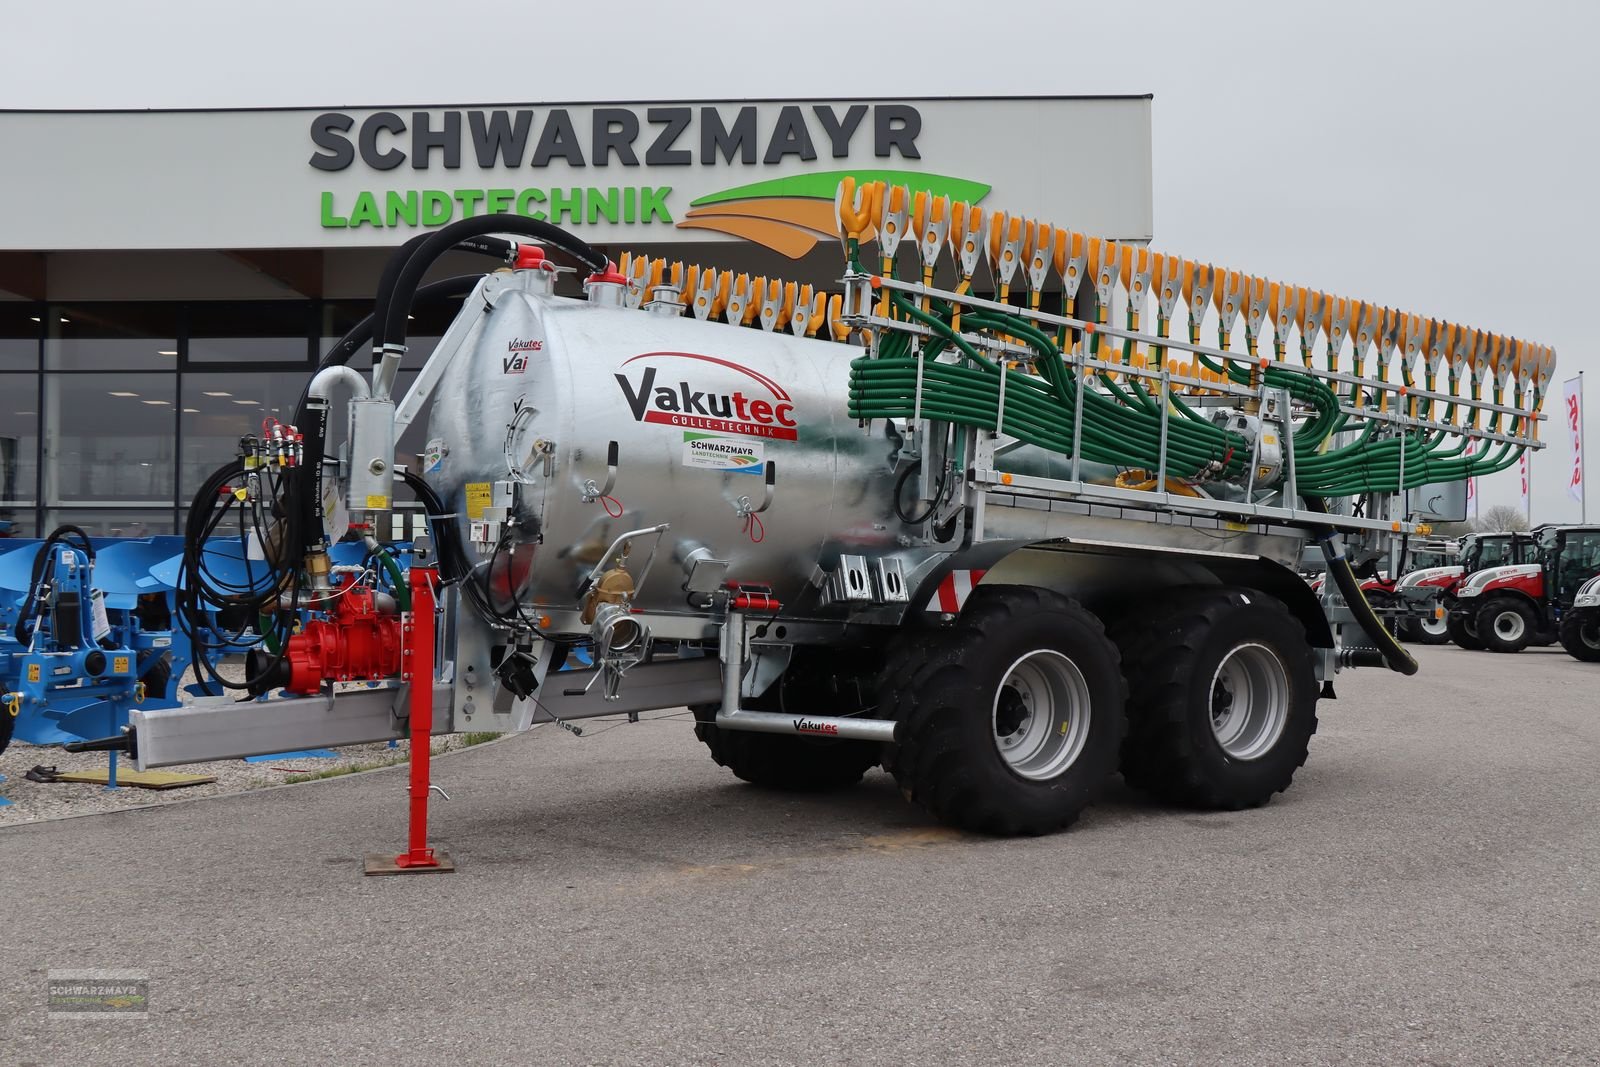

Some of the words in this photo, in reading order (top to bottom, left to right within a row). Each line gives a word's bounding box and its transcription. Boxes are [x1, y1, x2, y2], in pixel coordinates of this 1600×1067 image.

[308, 104, 922, 171] SCHWARZMAYR
[320, 186, 674, 227] LANDTECHNIK
[508, 337, 543, 352] Vakutec
[503, 352, 528, 374] Vai
[614, 367, 797, 427] Vakutec
[691, 441, 754, 456] SCHWARZMAYR
[1499, 568, 1518, 576] STEYR
[793, 717, 838, 731] Vakutec
